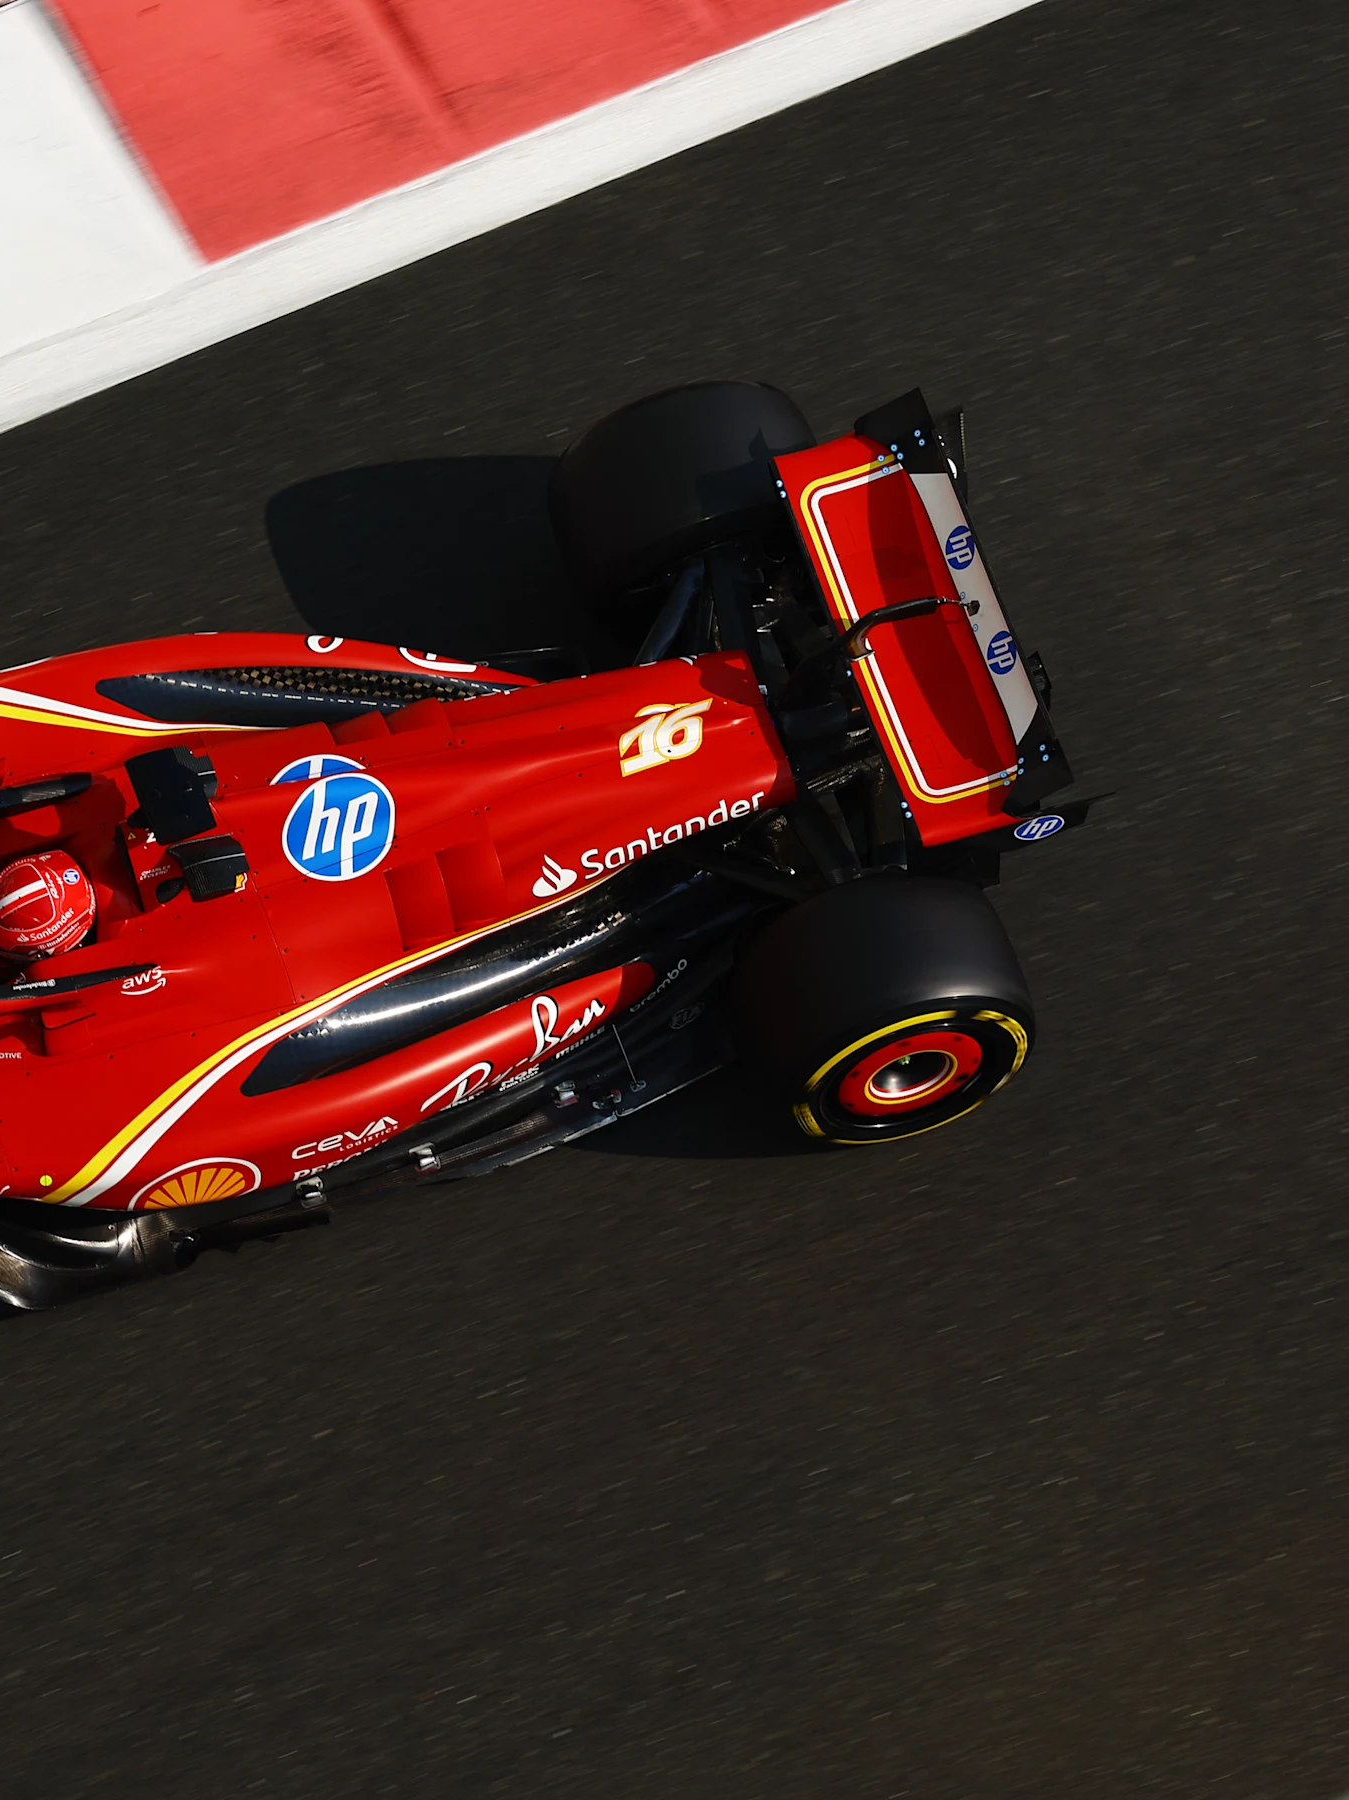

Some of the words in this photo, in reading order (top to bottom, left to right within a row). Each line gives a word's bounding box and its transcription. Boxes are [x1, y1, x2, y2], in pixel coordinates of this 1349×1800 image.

[946, 529, 975, 568] hp
[987, 635, 1016, 672] hp
[619, 697, 714, 778] 16
[300, 778, 380, 878] hp
[580, 791, 765, 881] Santander
[1023, 816, 1059, 840] hp
[30, 908, 74, 942] Santander
[121, 965, 162, 989] aws
